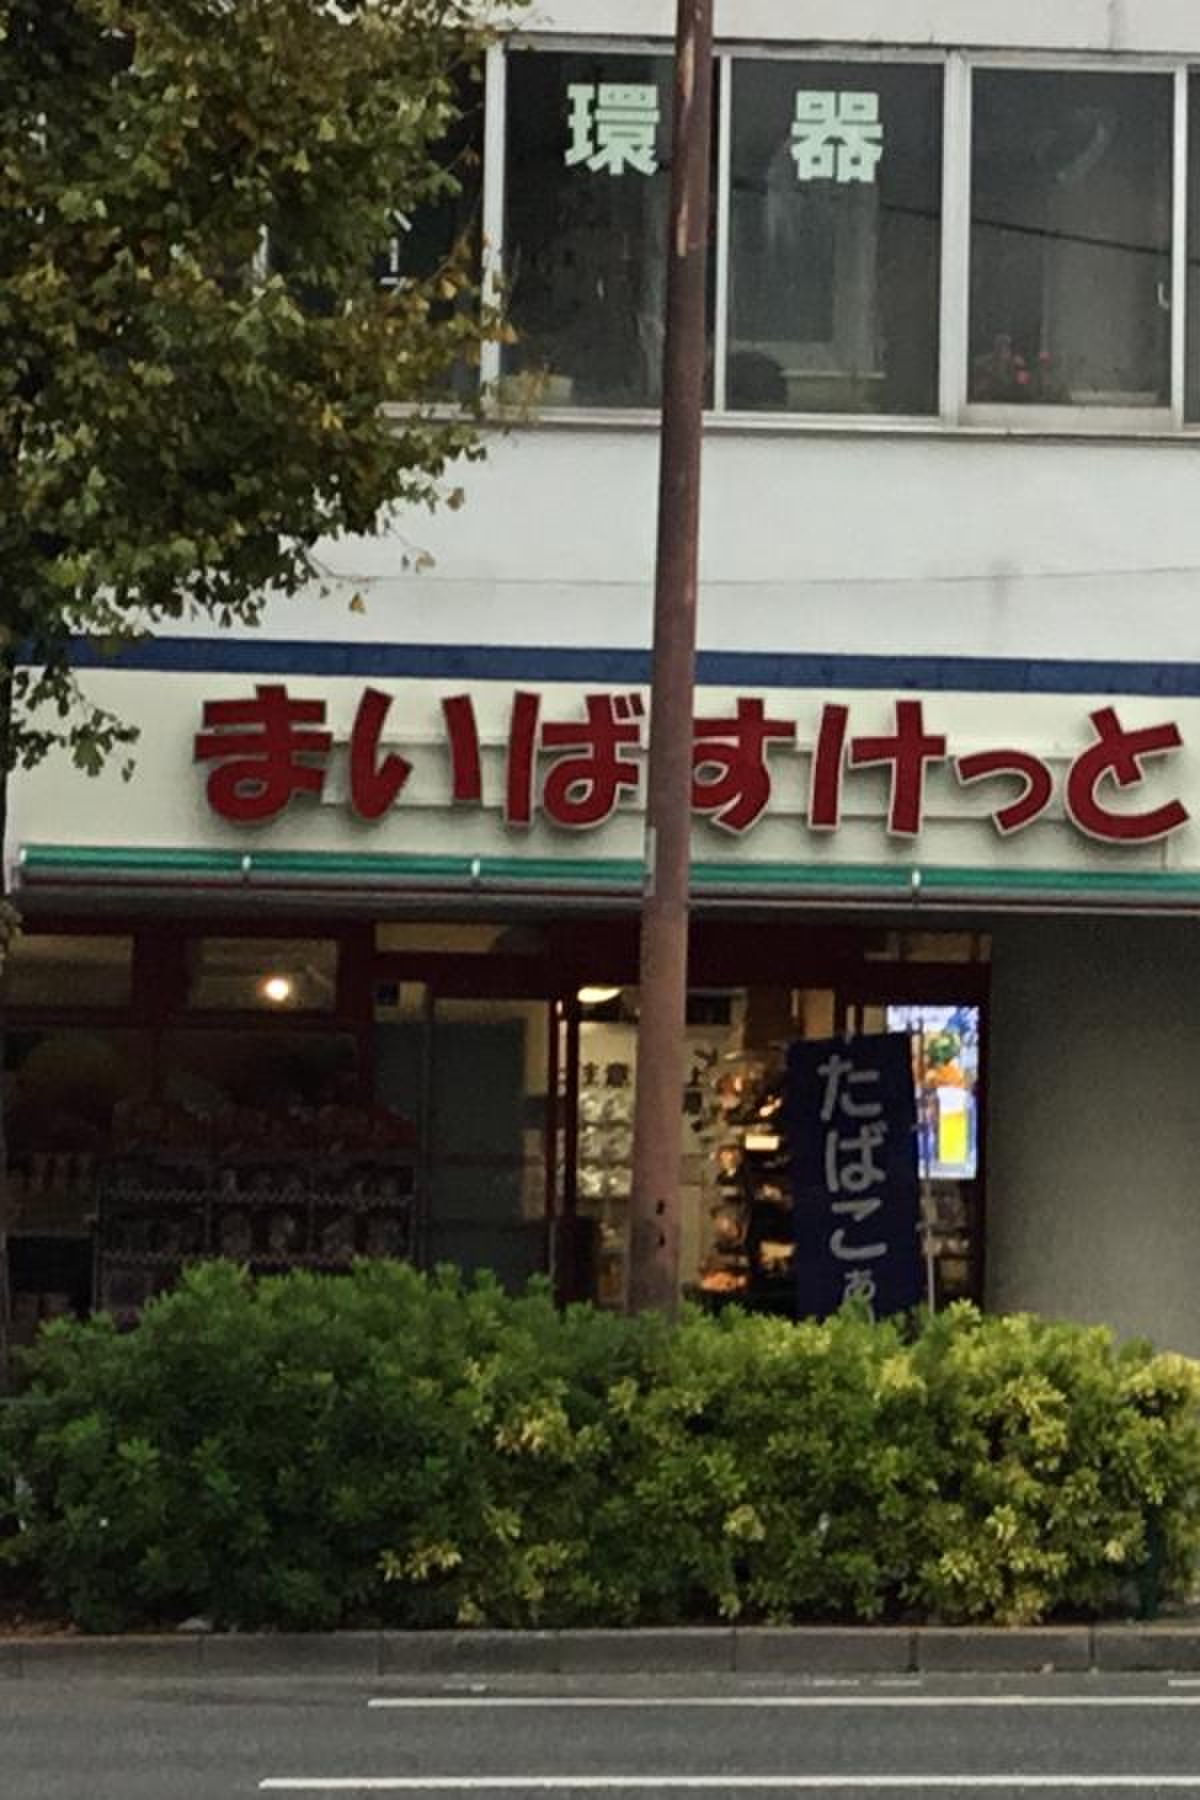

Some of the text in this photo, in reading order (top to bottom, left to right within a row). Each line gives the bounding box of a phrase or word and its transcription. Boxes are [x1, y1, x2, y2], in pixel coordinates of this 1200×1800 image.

[194, 683, 1191, 845] まいばすけっと
